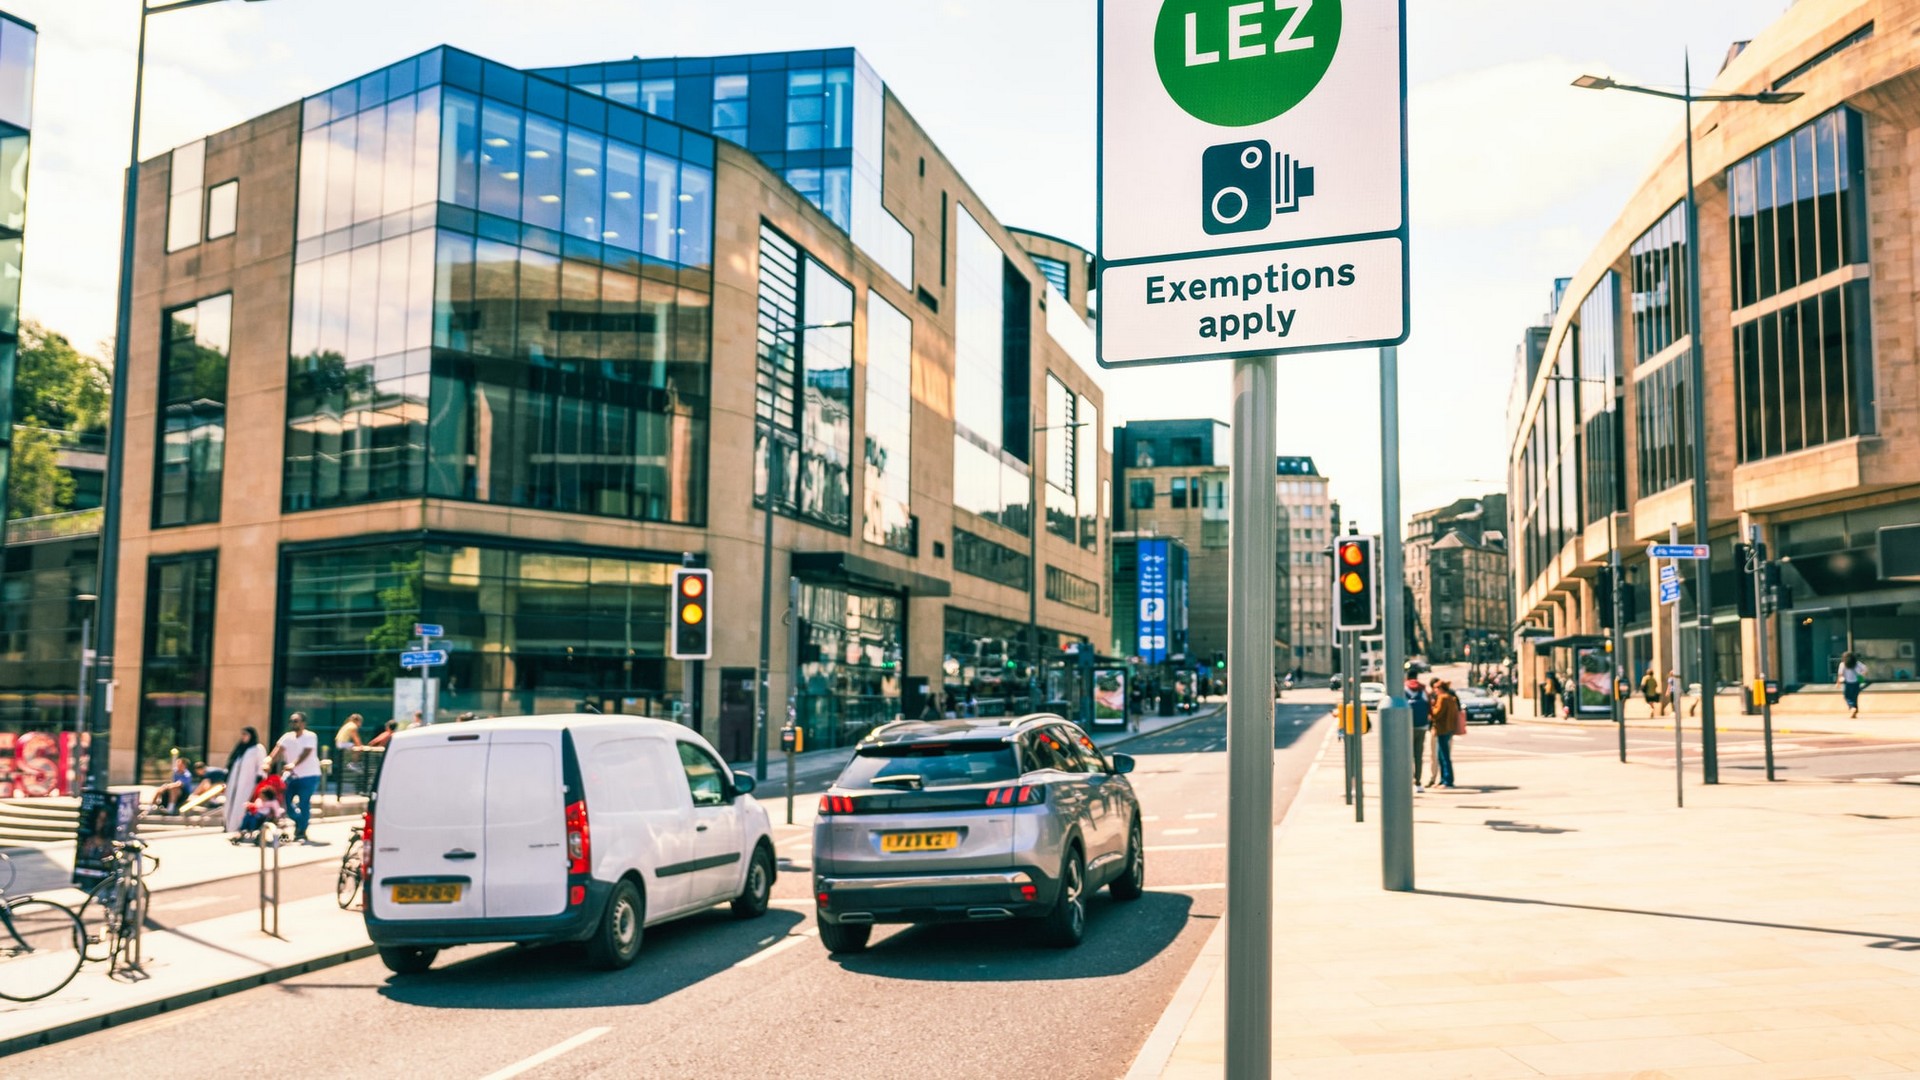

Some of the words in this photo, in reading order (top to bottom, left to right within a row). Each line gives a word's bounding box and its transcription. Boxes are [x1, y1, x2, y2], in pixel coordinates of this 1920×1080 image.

[1185, 0, 1314, 67] LEZ
[1146, 263, 1356, 304] Exemptions
[1199, 304, 1296, 342] apply
